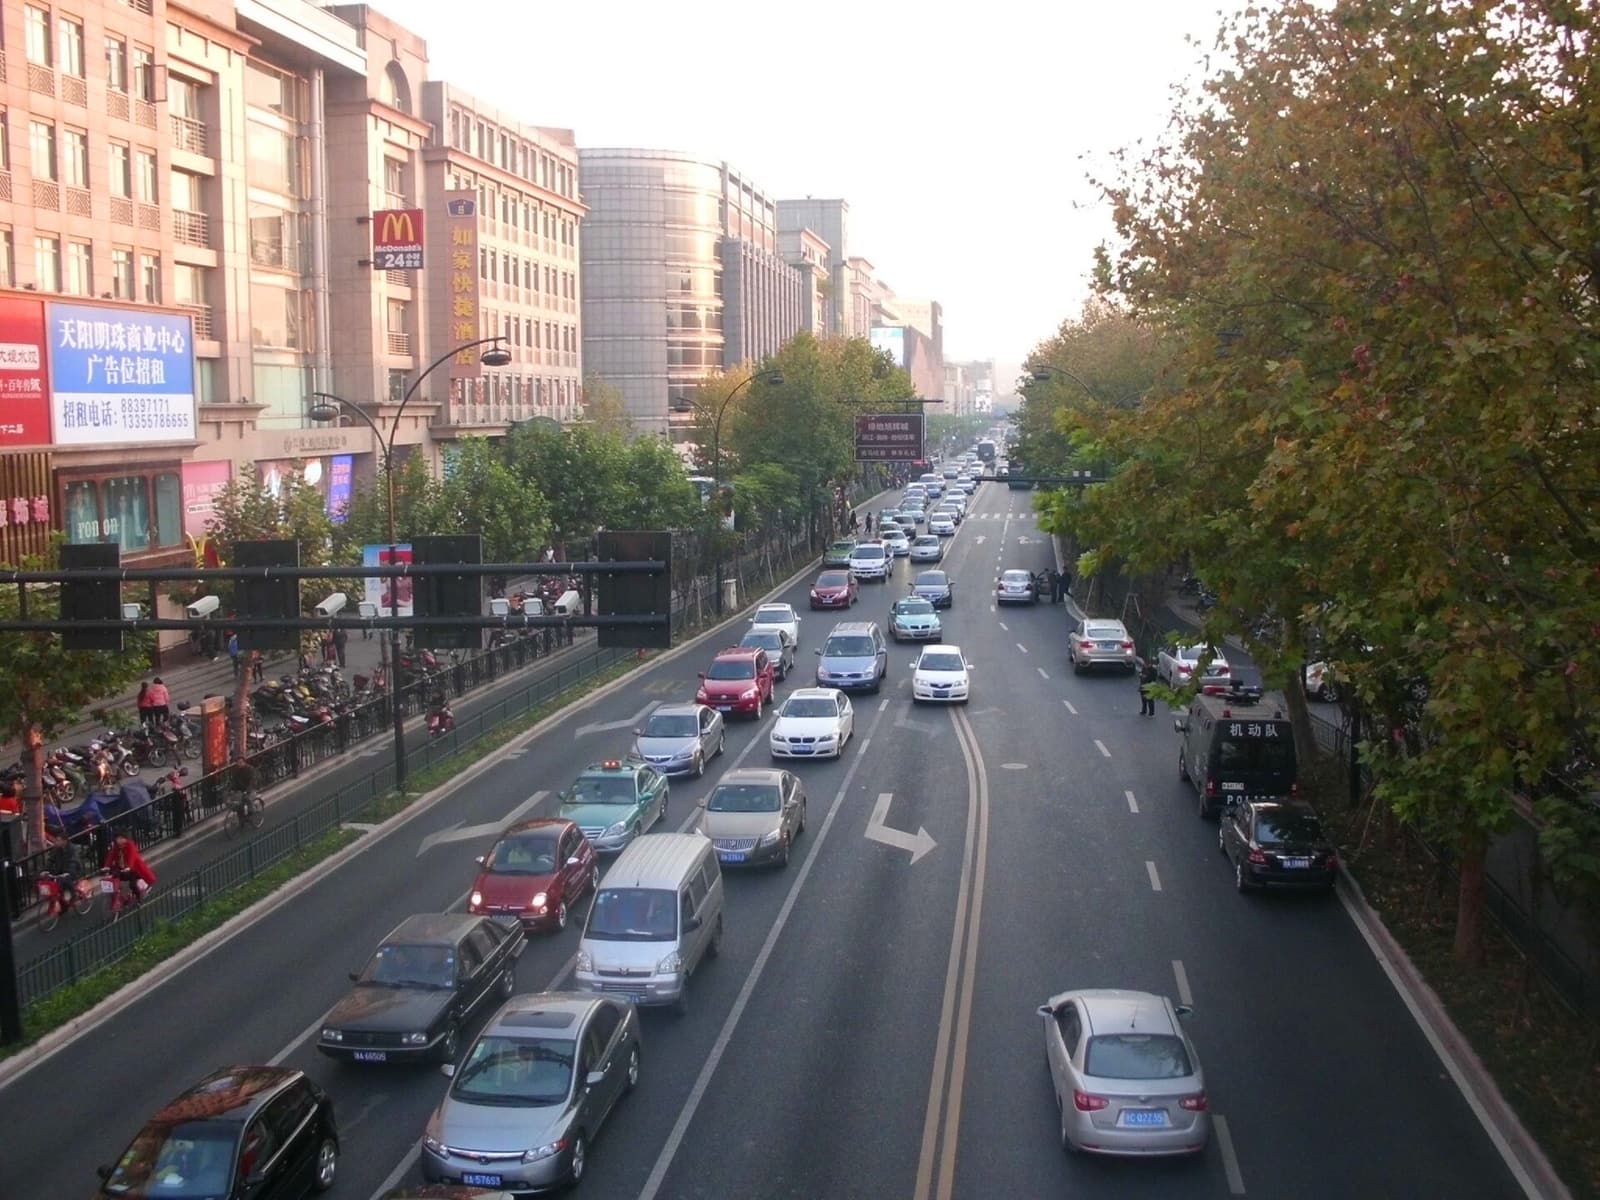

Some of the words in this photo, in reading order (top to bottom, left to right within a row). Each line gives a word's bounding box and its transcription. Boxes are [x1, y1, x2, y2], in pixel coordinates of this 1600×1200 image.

[384, 253, 404, 268] 24
[452, 226, 474, 366] 如家快捷酒店
[58, 318, 186, 355] 天阳明珠商业中心
[86, 353, 166, 385] 广告位招租
[121, 398, 169, 413] 88397171
[122, 413, 189, 429] 13355786655
[1229, 723, 1278, 737] 机动队
